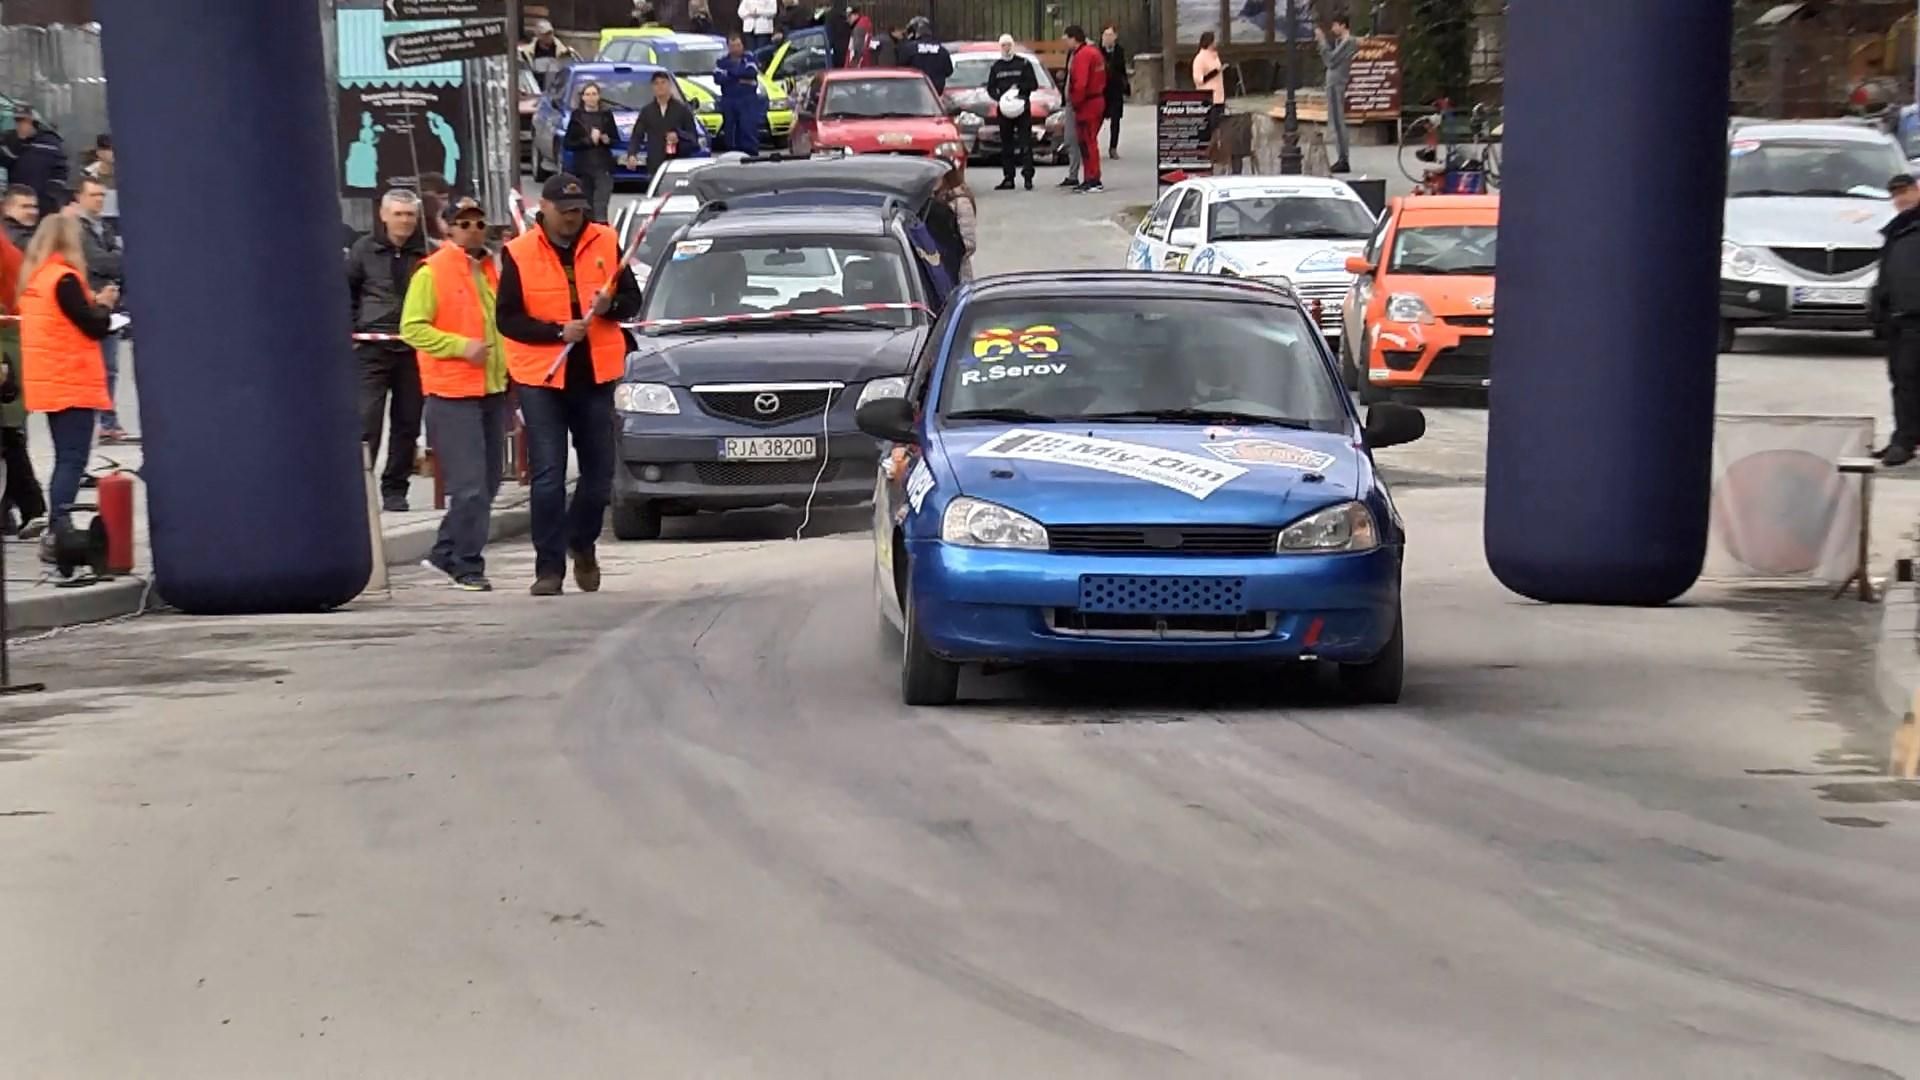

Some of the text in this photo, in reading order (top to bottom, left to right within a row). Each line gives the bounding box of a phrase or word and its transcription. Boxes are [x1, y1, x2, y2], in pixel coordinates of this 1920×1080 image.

[961, 363, 1067, 386] R.Serov
[727, 439, 813, 456] RJA 38200
